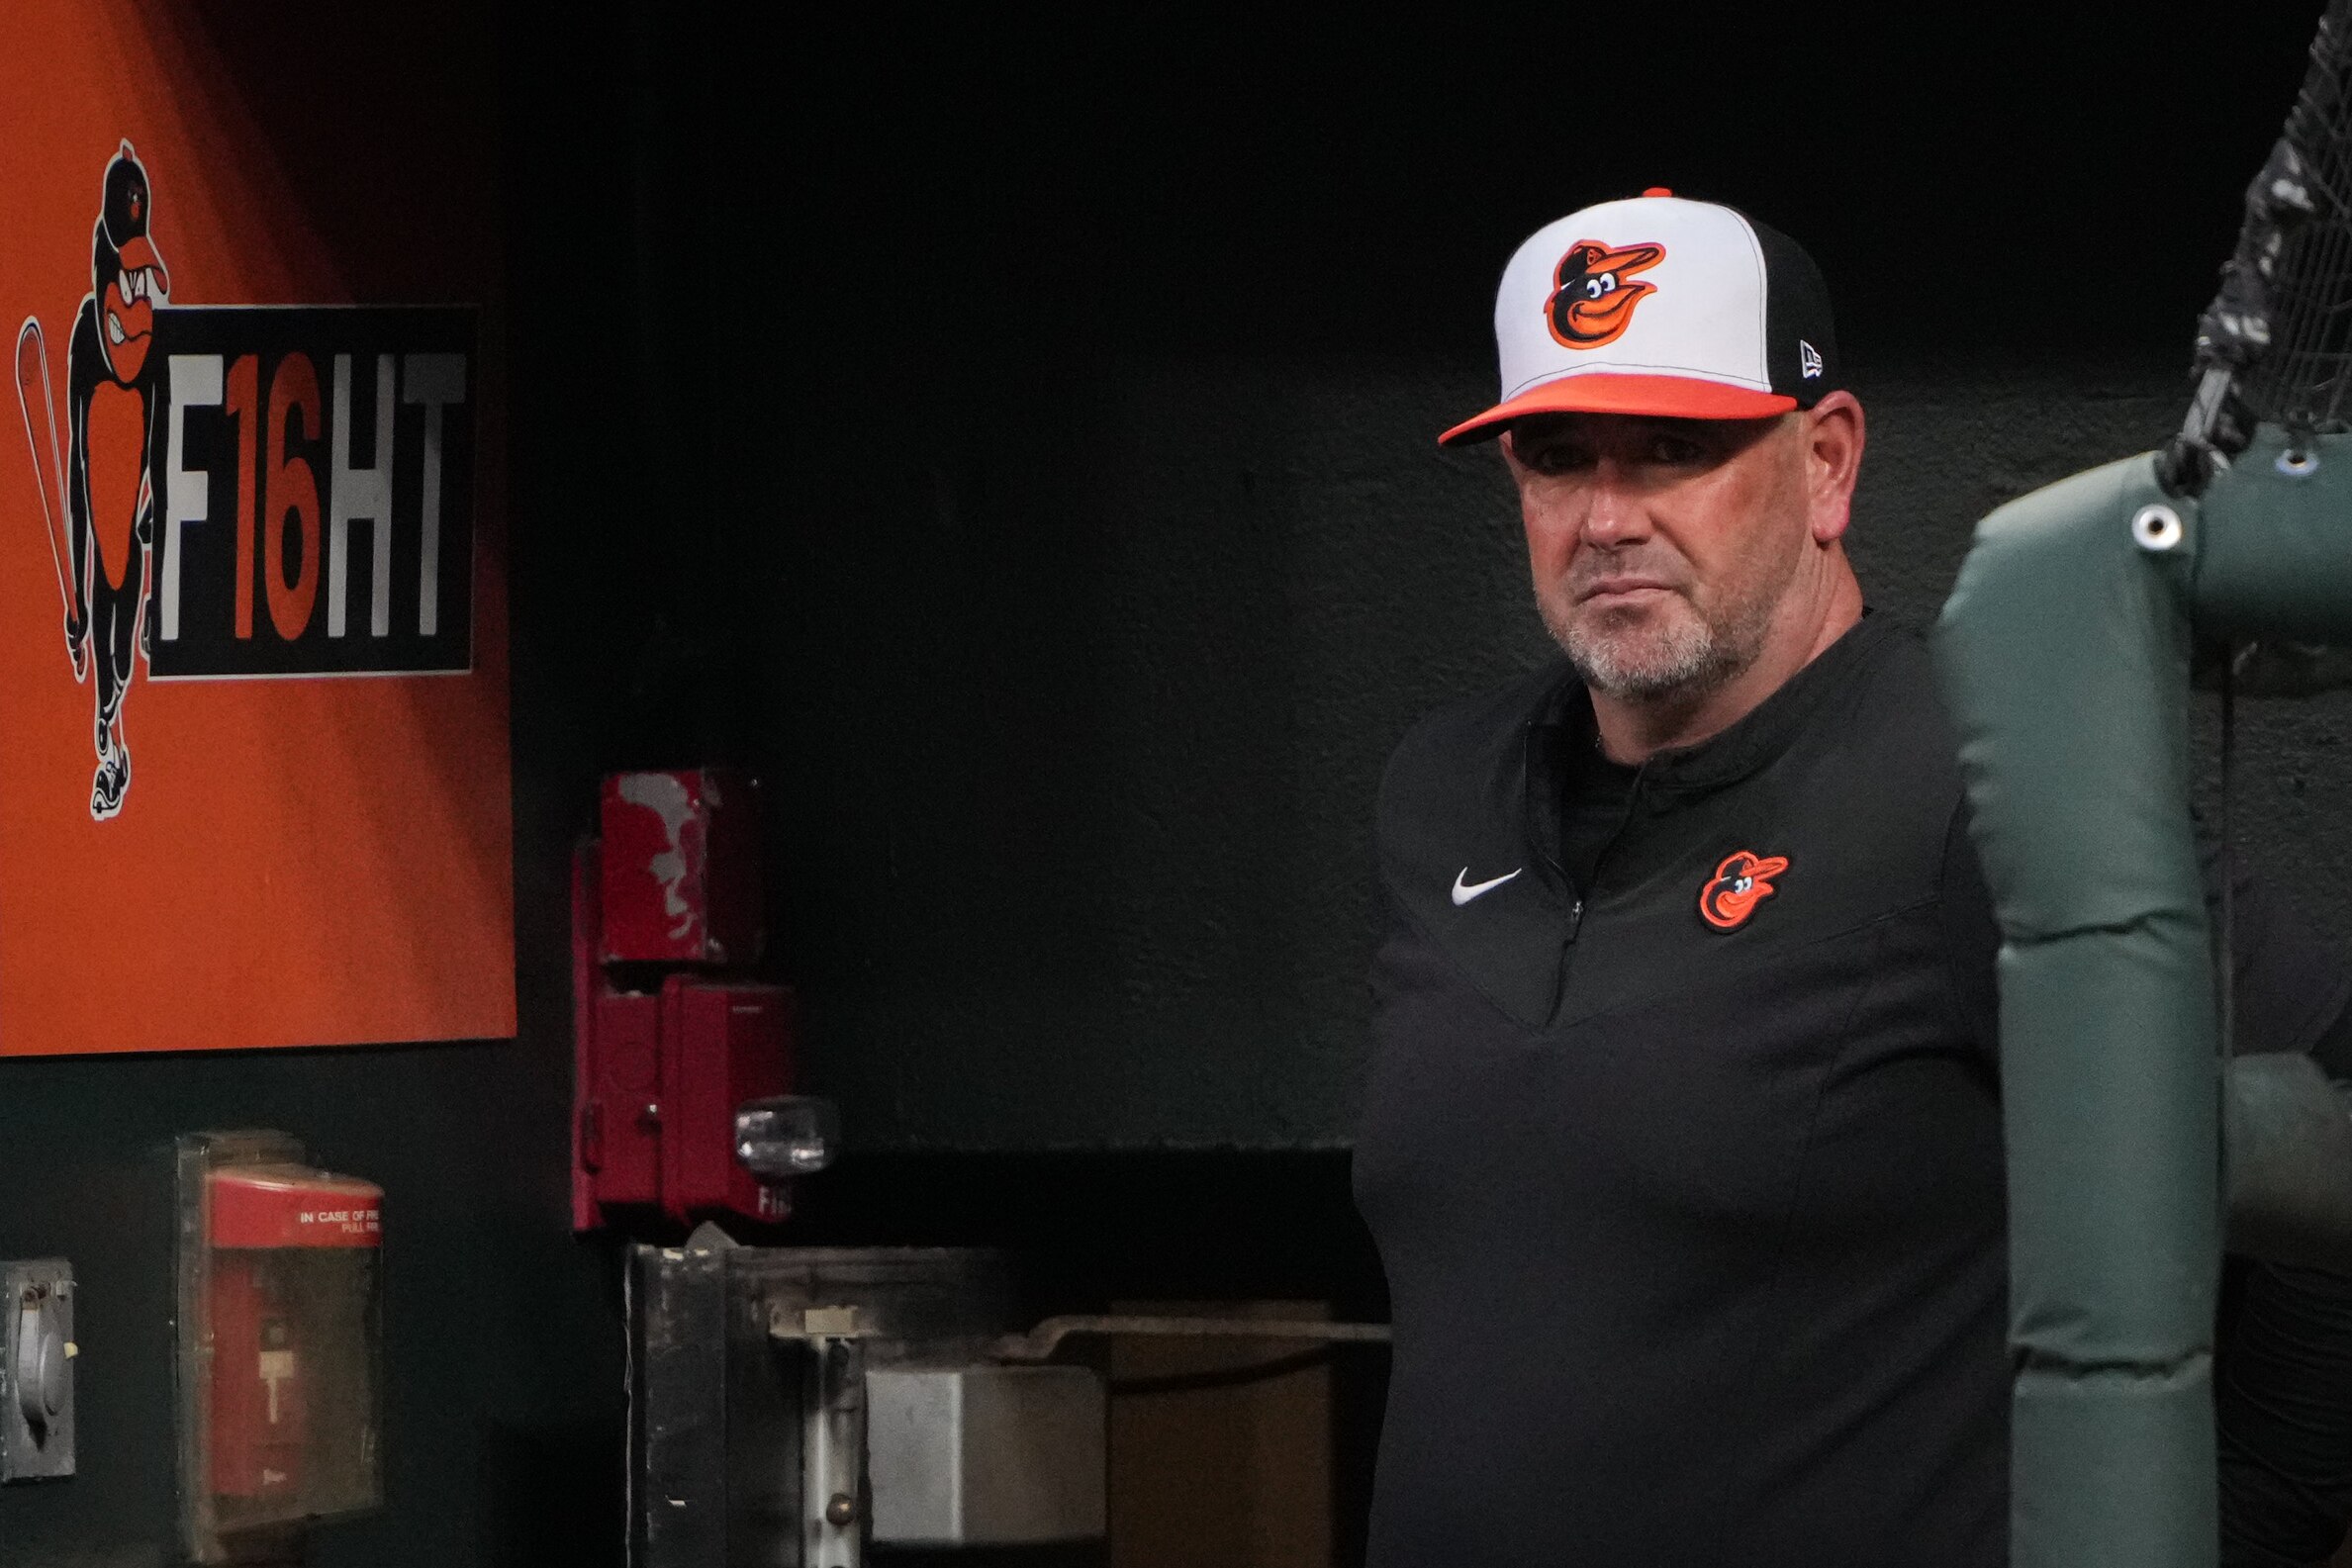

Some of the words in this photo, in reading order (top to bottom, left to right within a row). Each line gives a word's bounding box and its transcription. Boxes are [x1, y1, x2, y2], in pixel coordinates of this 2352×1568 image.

[160, 351, 467, 641] F16HT
[300, 1212, 314, 1224] IN
[318, 1211, 348, 1223] CASE
[352, 1210, 365, 1222] OF
